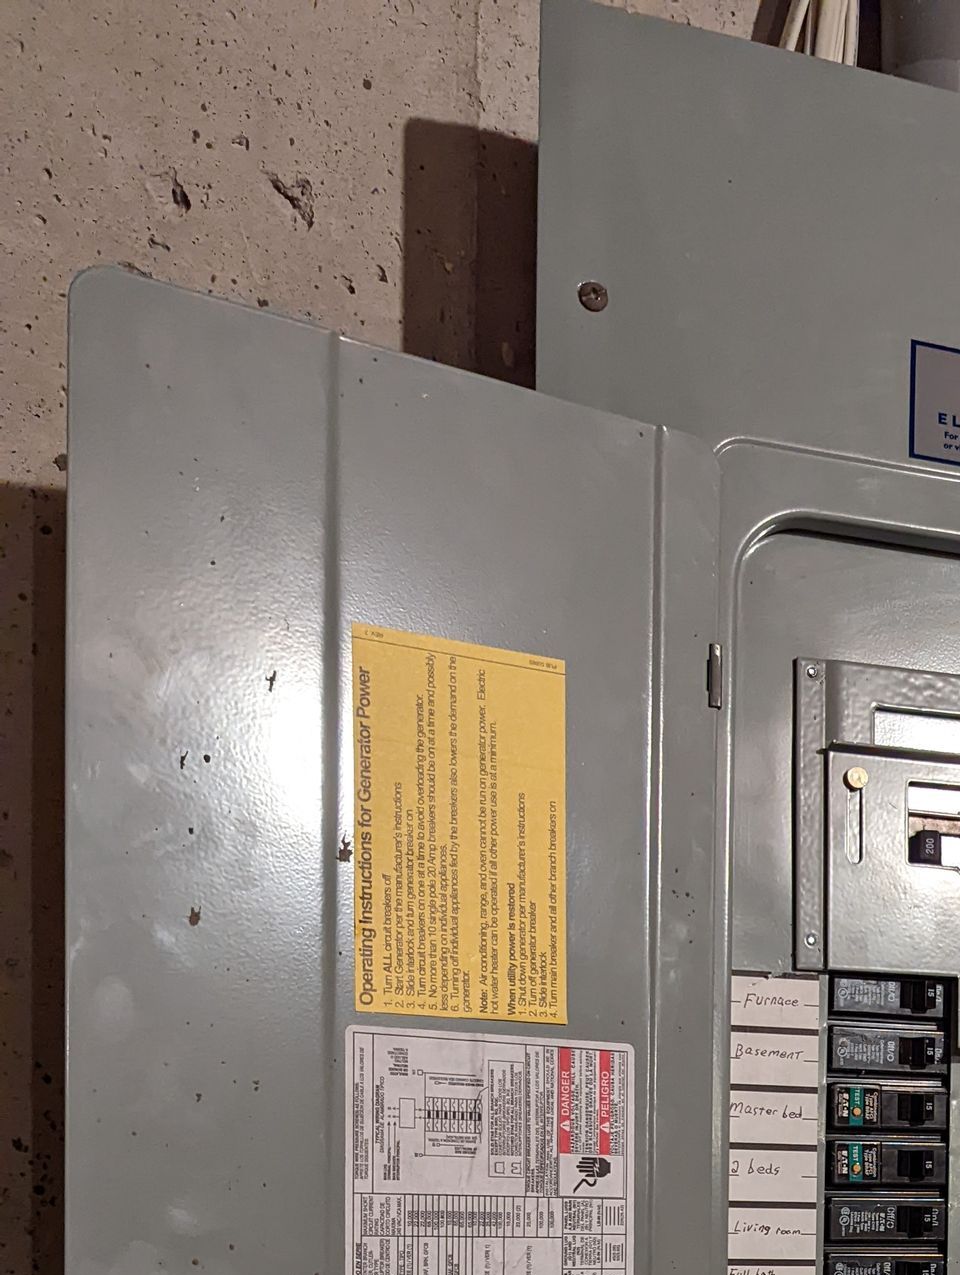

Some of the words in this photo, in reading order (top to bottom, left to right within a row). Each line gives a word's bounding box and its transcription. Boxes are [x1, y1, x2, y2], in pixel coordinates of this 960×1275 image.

[945, 432, 958, 440] For
[357, 667, 370, 718] Power
[357, 722, 372, 802] Generator
[358, 805, 372, 827] for
[393, 783, 402, 830] instructions
[406, 810, 414, 820] on
[517, 793, 526, 839] instructions
[549, 801, 556, 812] on
[405, 823, 414, 855] breaker
[926, 838, 934, 855] 200
[358, 832, 372, 924] Instructions
[382, 873, 391, 885] off
[406, 858, 415, 899] generator
[507, 883, 515, 921] restored
[549, 883, 557, 904] other
[383, 887, 391, 926] breakers
[395, 899, 403, 912] the
[519, 905, 527, 918] per
[549, 906, 557, 914] all
[396, 915, 405, 928] per
[528, 901, 536, 933] breaker
[549, 916, 557, 933] and
[406, 920, 414, 936] and
[383, 927, 392, 951] circuit
[508, 932, 517, 961] power
[519, 920, 528, 960] generator
[395, 930, 403, 973] Generator
[407, 938, 415, 973] interlock
[529, 935, 538, 975] generator
[549, 935, 557, 966] breaker
[359, 928, 376, 1005] Operating
[383, 953, 392, 973] ALL
[518, 962, 526, 985] down
[539, 952, 547, 986] interlock
[384, 975, 392, 994] Turn
[407, 975, 415, 996] Slide
[507, 963, 517, 987] utility
[528, 976, 537, 987] off
[395, 976, 403, 996] Start
[518, 987, 526, 1006] Shut
[508, 989, 516, 1015] When
[529, 989, 537, 1007] Turn
[539, 987, 547, 1008] Slide
[550, 990, 558, 1008] Turn
[744, 993, 798, 1008] Furnace
[736, 1044, 803, 1060] Basement
[561, 1071, 570, 1116] DANGER
[601, 1071, 610, 1118] PELIGRO
[730, 1102, 778, 1116] Master
[782, 1100, 803, 1119] bed
[748, 1158, 780, 1175] beds
[734, 1221, 770, 1235] Living
[775, 1227, 801, 1235] room
